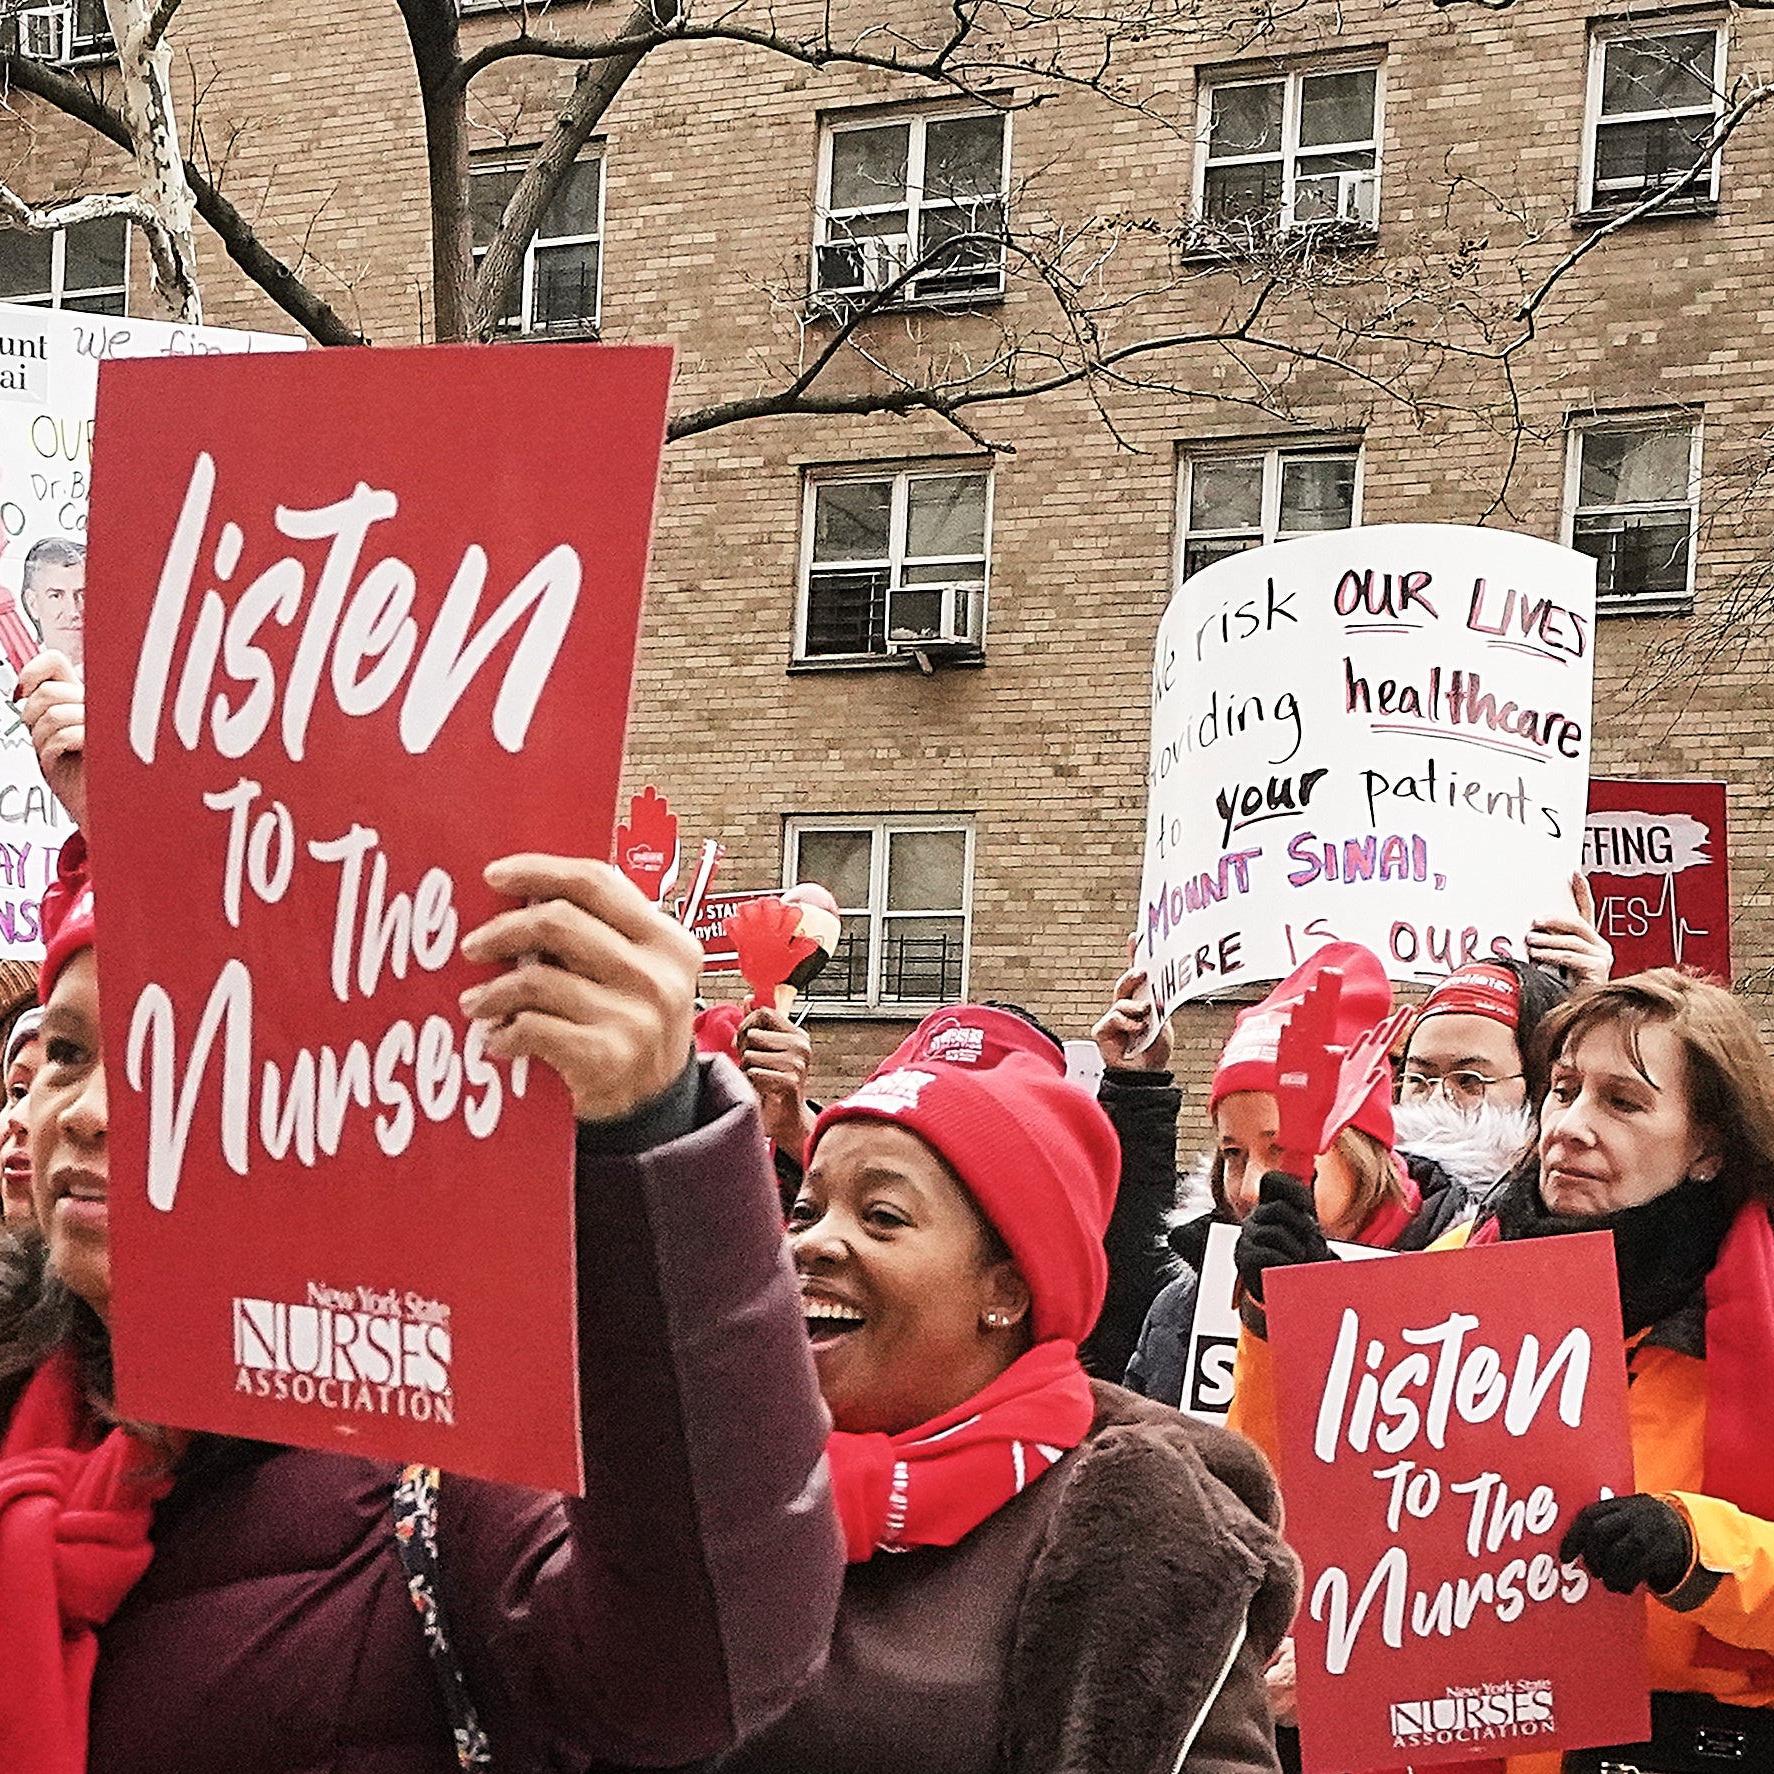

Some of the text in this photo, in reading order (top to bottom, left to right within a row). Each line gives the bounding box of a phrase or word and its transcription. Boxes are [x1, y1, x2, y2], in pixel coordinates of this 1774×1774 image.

[1196, 569, 1588, 661] risk OUR LIVES
[1342, 656, 1582, 759] healthcare
[1157, 758, 1562, 860] to your patients
[1148, 846, 1262, 957] MOUNT
[1151, 931, 1244, 1023] WHERE
[307, 1280, 355, 1310] New
[356, 1286, 402, 1317] York
[233, 1297, 453, 1393] NURSES
[234, 1366, 457, 1426] ASSOCIATION
[1390, 1690, 1554, 1736] NURSES
[1393, 1719, 1556, 1749] ASSOCIATION
[1446, 1678, 1553, 1699] New York State
